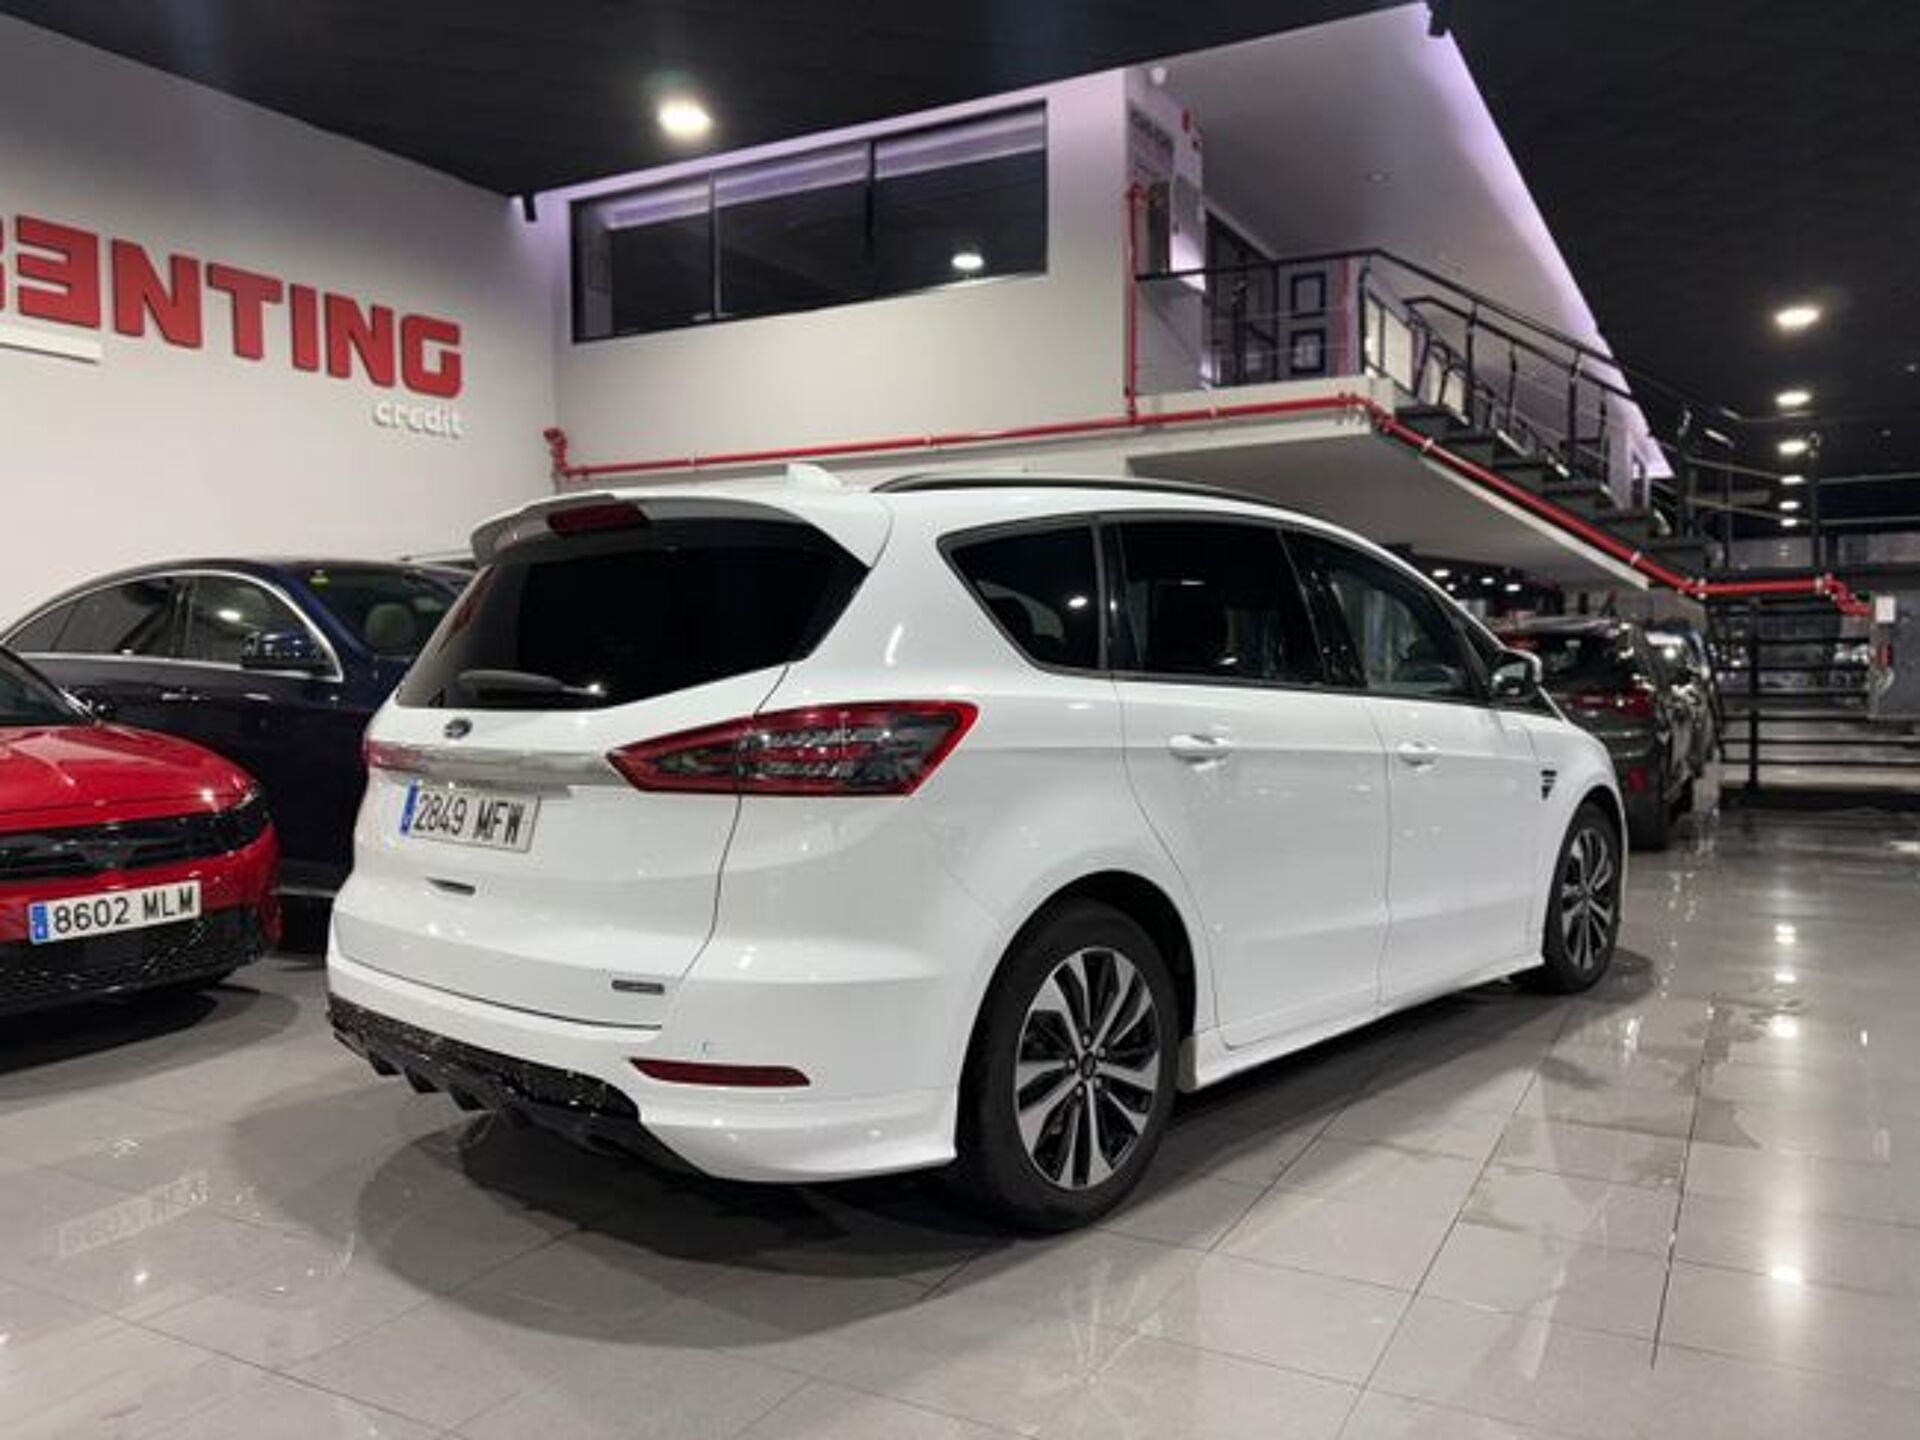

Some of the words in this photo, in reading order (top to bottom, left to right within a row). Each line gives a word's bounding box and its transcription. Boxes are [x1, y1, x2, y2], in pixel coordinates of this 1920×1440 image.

[0, 214, 462, 399] ENTING
[413, 794, 467, 836] 2849
[473, 799, 525, 844] MFW
[54, 897, 130, 934] 8602
[142, 886, 193, 920] MLM
